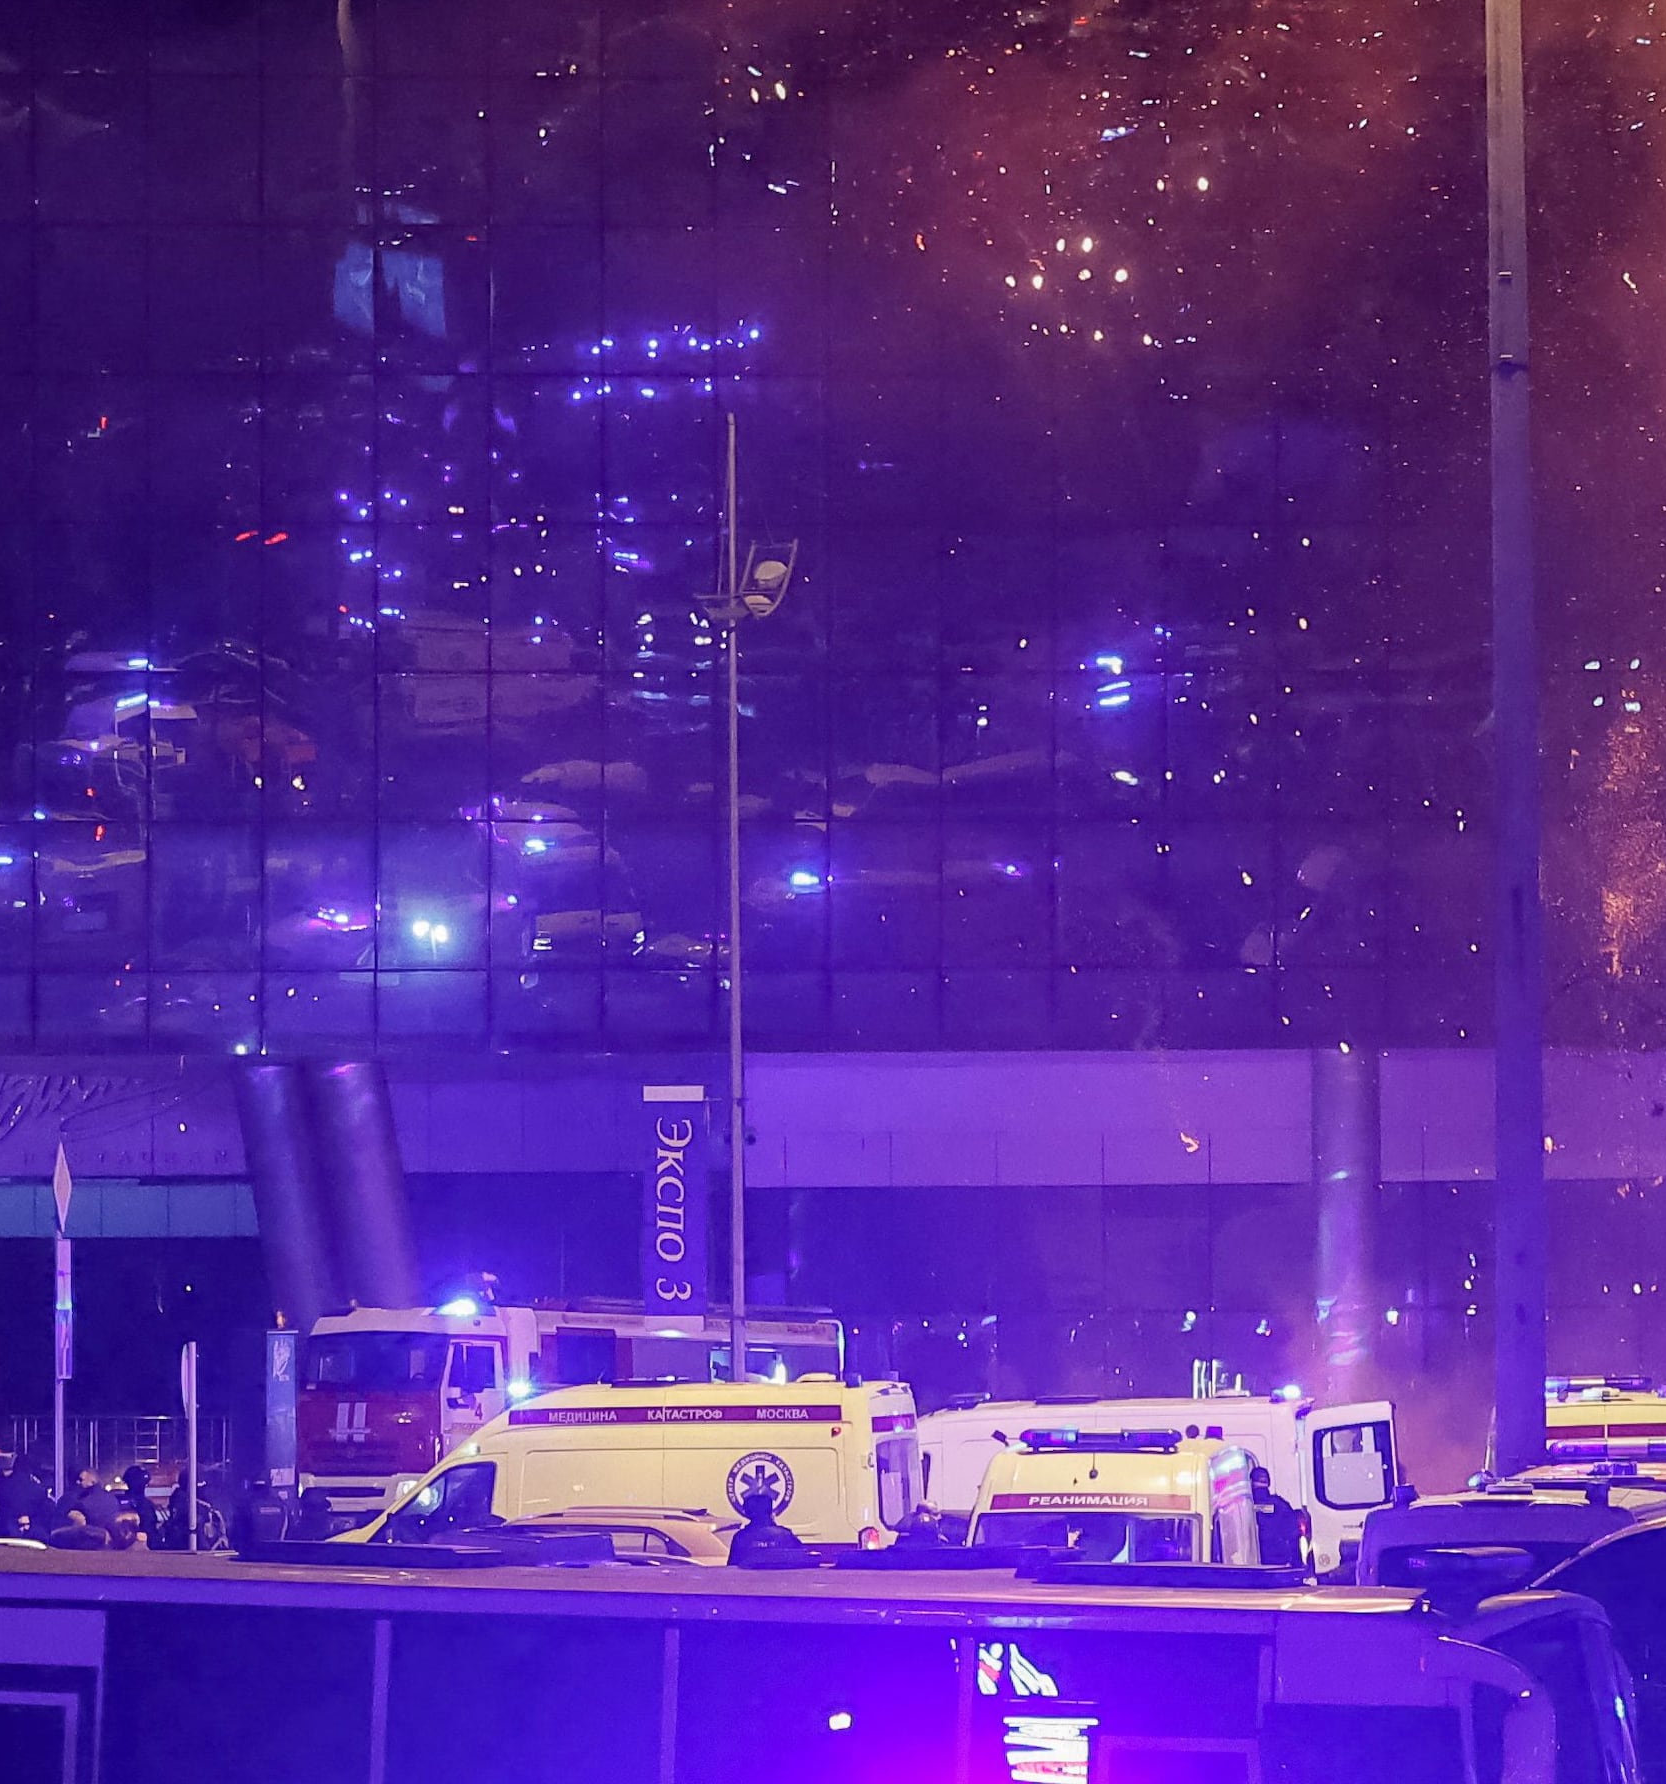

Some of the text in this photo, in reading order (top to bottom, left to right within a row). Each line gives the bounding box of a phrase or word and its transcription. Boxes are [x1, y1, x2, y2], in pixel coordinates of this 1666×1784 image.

[656, 1277, 693, 1301] 3
[473, 1403, 483, 1420] 4
[548, 1408, 809, 1424] МЕДИЦИНА КАТАСТРОФ МОСКВА
[1028, 1495, 1149, 1506] РЕАНИМАЦИЯ
